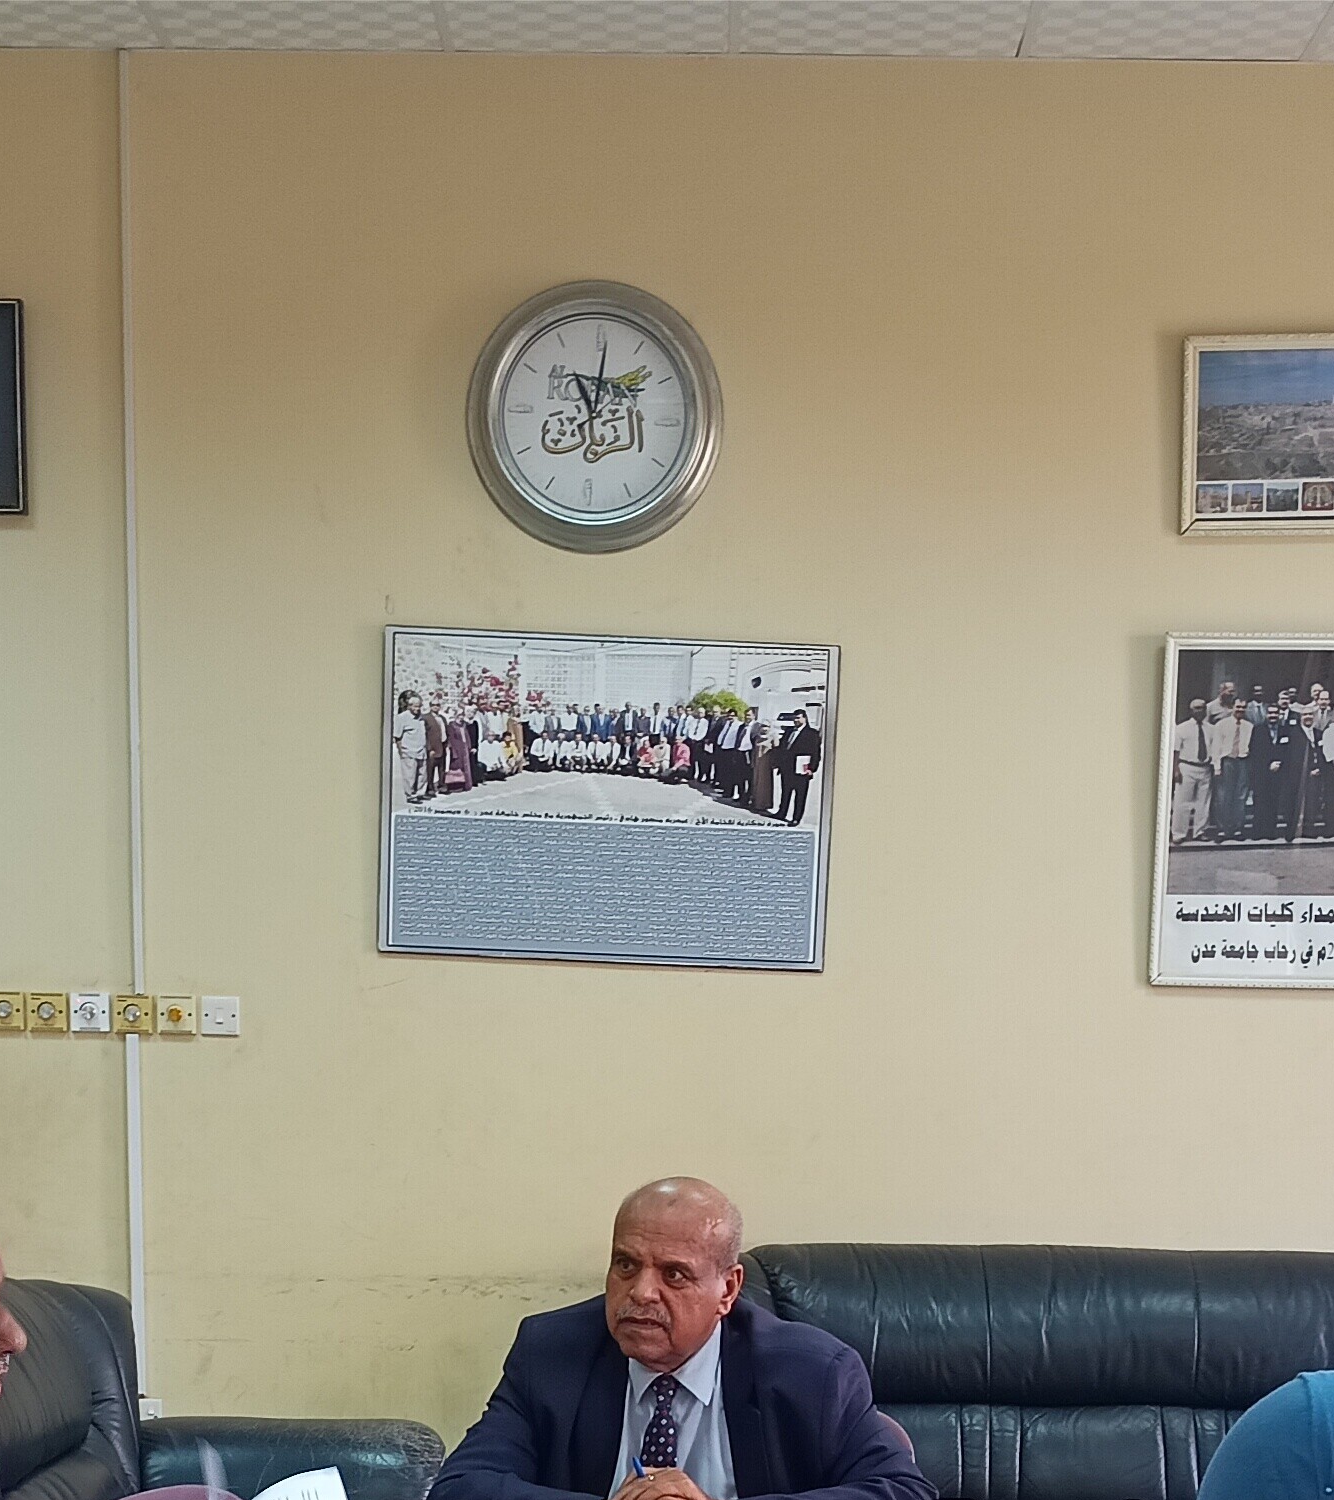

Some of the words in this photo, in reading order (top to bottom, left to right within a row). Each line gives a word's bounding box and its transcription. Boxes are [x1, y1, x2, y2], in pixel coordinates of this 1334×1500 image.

[1176, 901, 1242, 923] الهندسة
[1248, 901, 1294, 927] كليات
[1191, 943, 1216, 963] عدن
[1221, 939, 1259, 963] جامعة
[1264, 940, 1296, 964] رحاب
[1300, 939, 1314, 968] في
